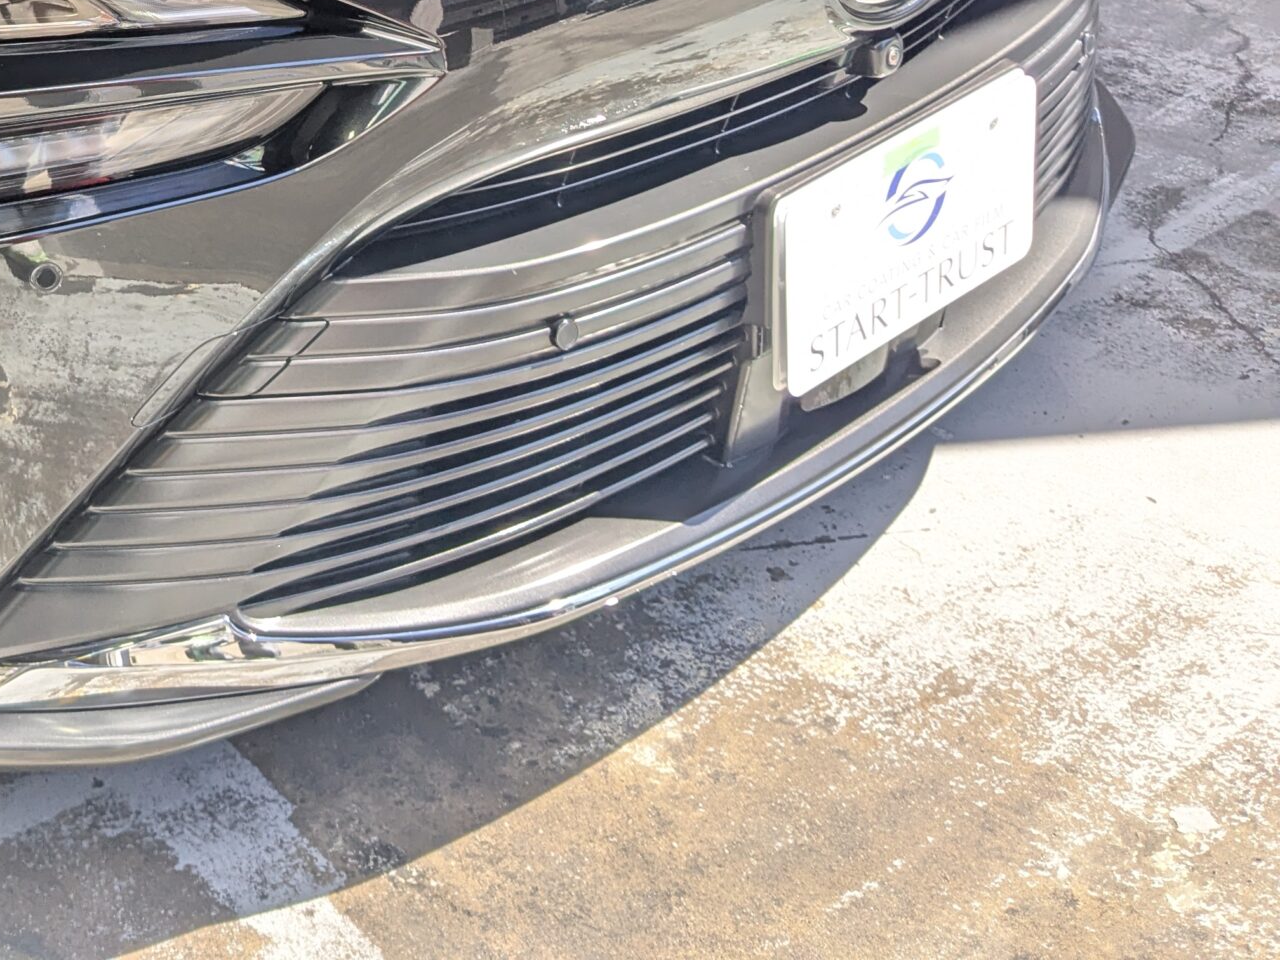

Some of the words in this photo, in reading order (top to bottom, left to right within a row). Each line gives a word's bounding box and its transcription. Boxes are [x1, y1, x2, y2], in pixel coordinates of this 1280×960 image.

[942, 224, 970, 250] CAR
[975, 202, 1008, 233] FILM
[809, 219, 1016, 373] START-TRUST
